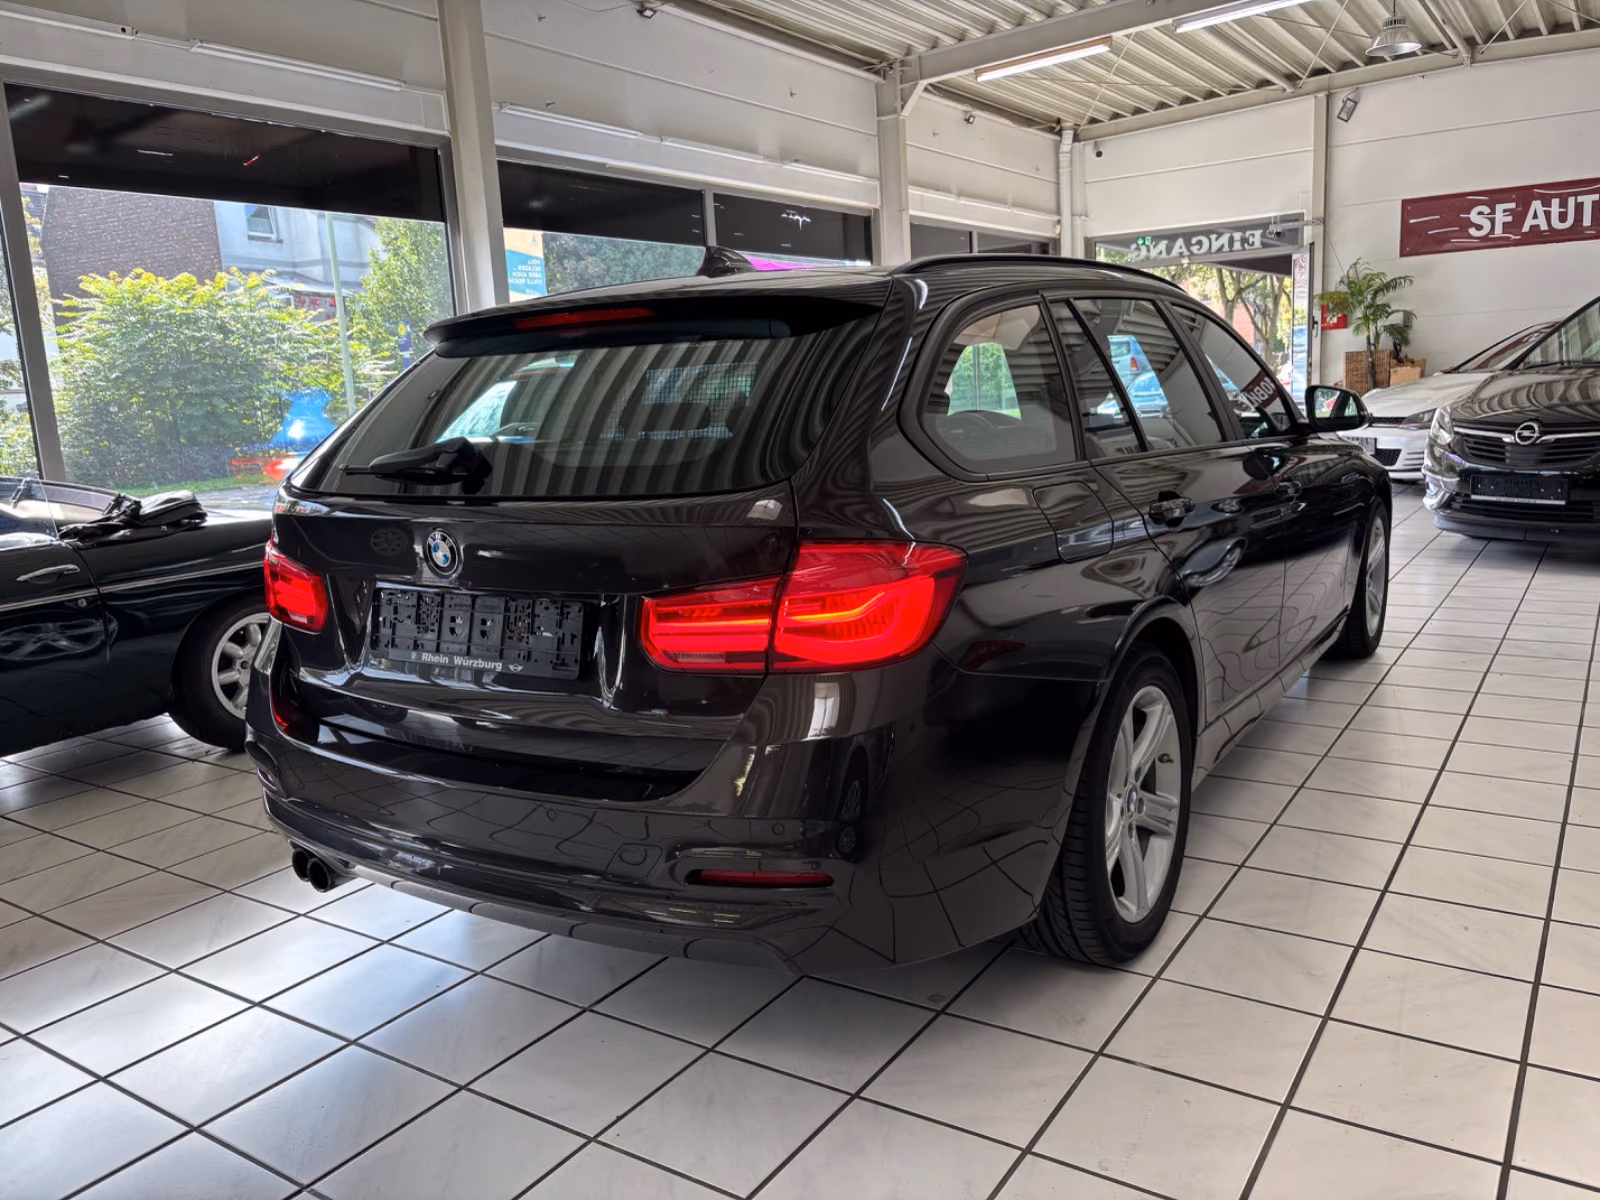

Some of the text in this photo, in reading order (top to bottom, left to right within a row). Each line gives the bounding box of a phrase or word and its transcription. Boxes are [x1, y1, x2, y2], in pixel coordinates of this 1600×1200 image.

[1468, 193, 1600, 238] SF AUT
[421, 651, 503, 671] Rhein Würzburg
